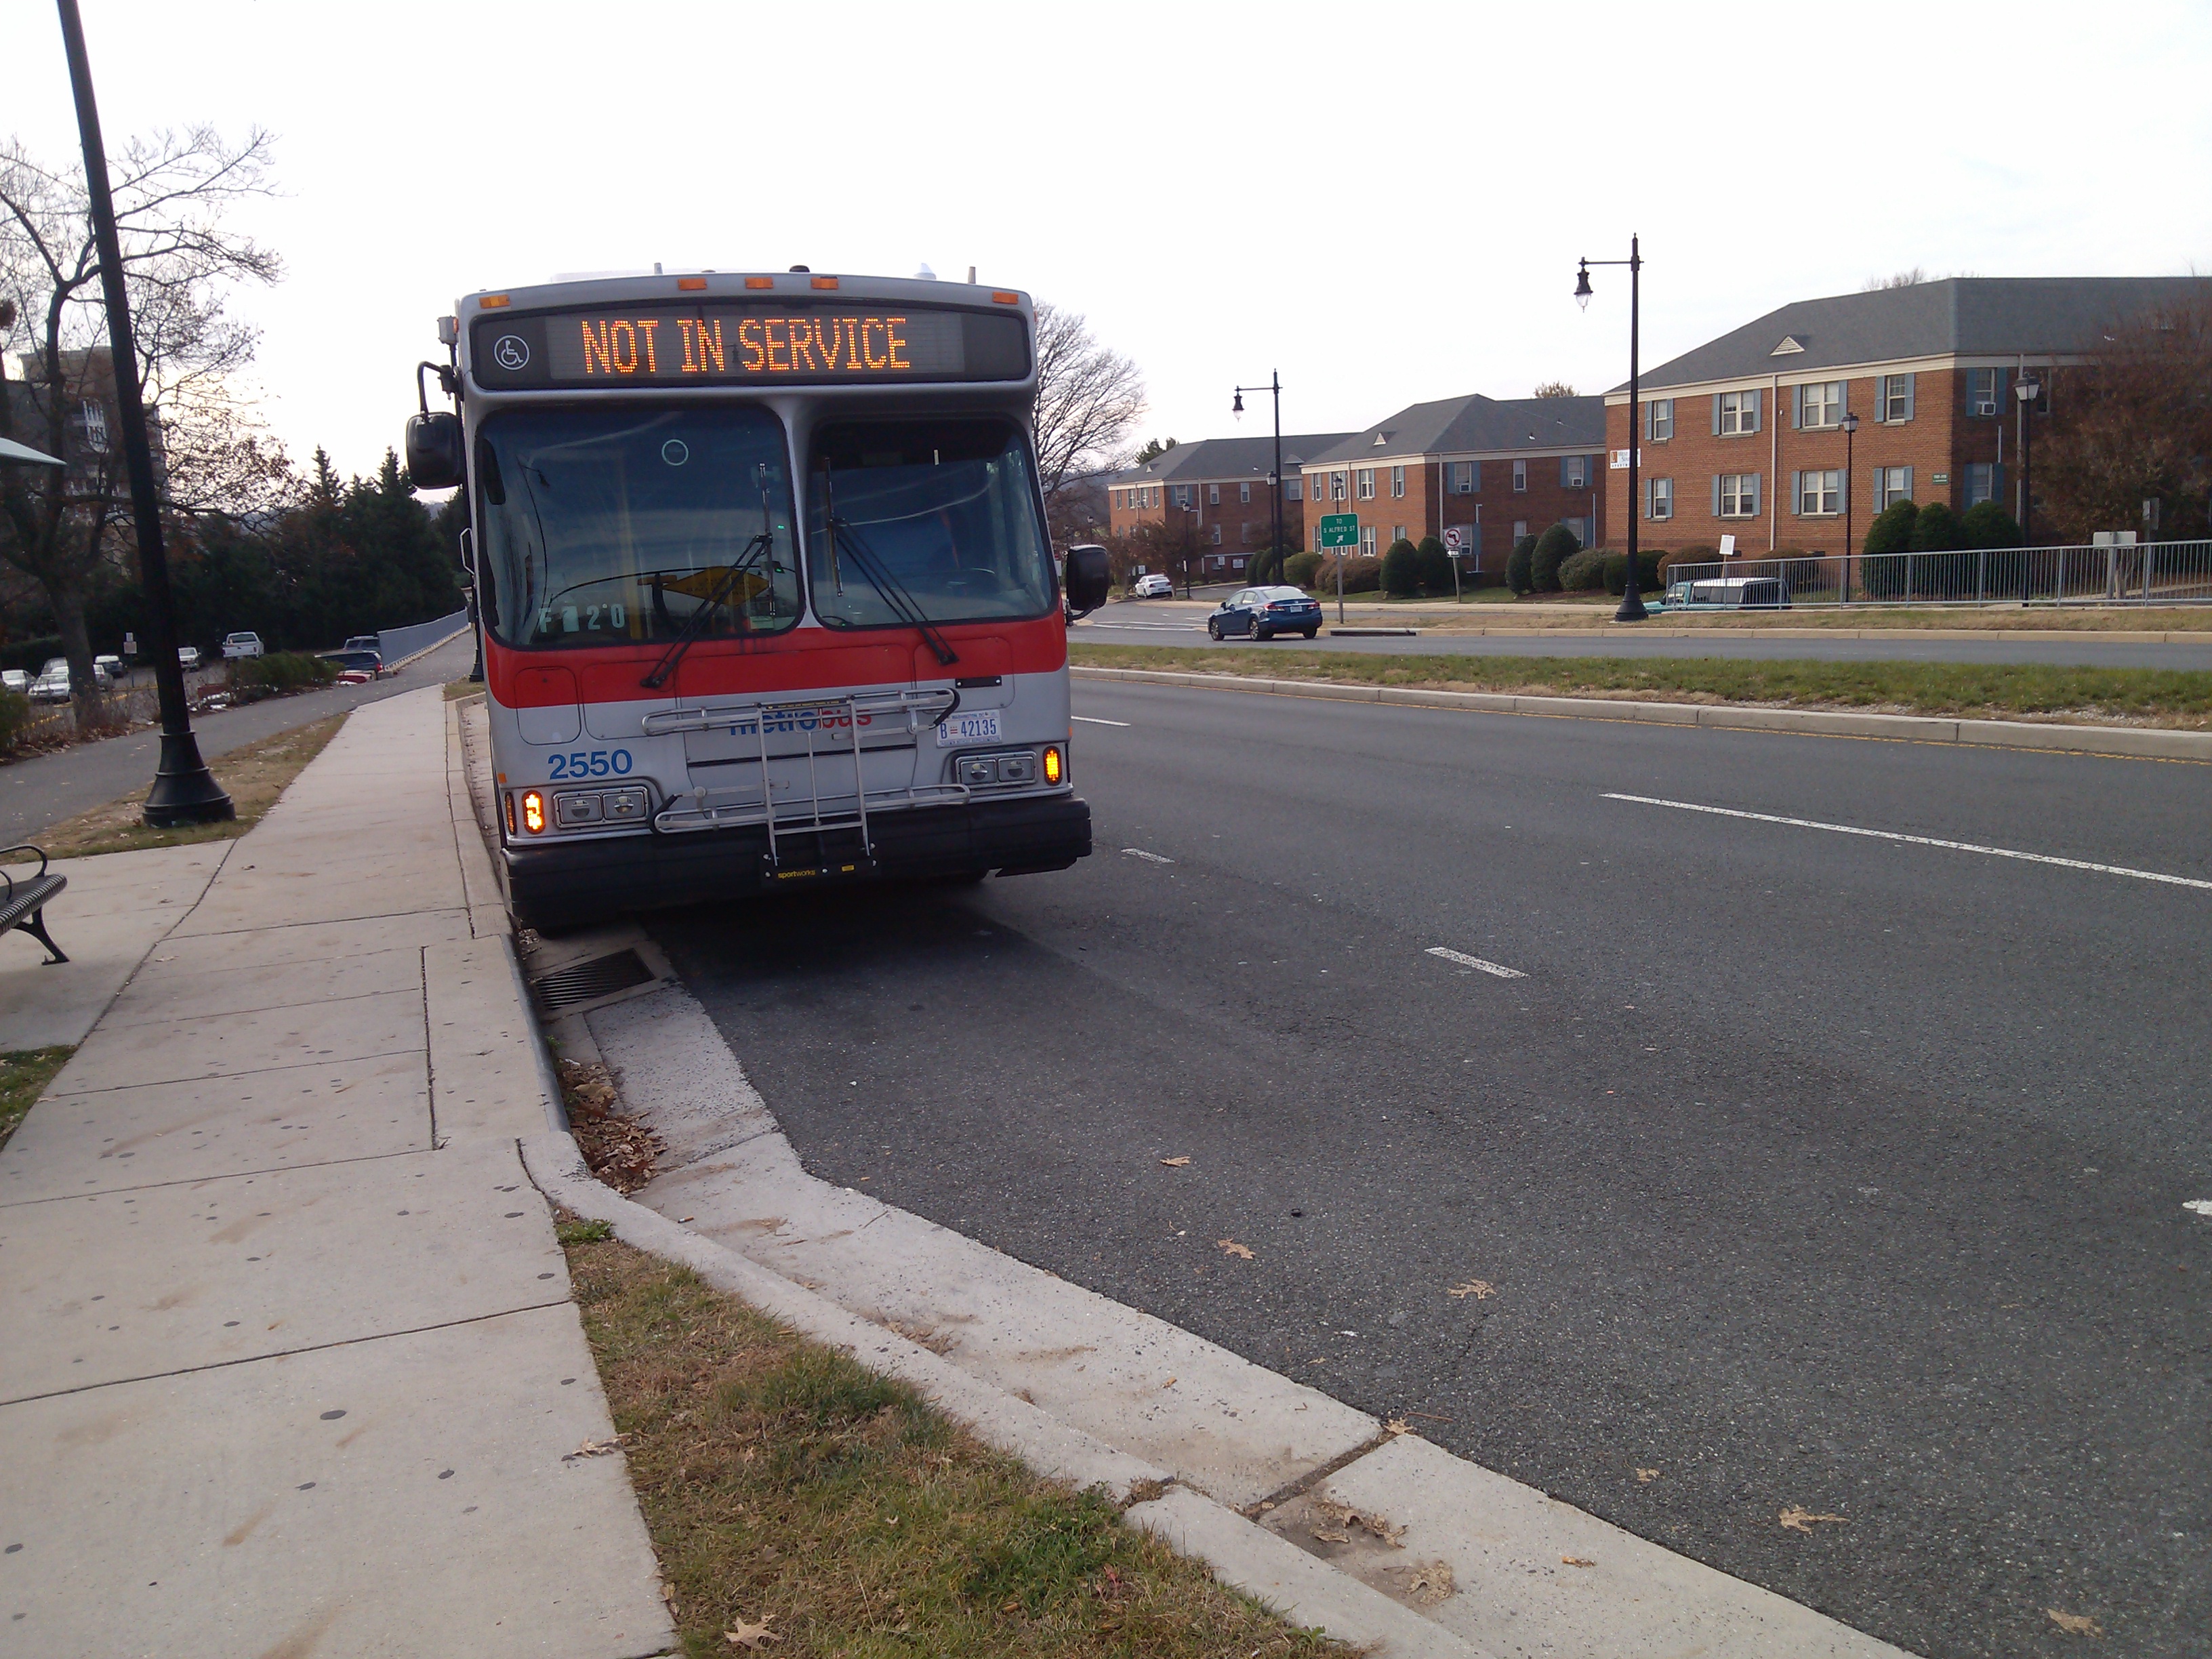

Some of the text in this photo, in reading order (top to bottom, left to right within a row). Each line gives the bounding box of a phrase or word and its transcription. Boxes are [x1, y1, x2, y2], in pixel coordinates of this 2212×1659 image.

[581, 317, 911, 373] NOT IN SERVICE
[940, 718, 997, 739] B 42135
[548, 749, 633, 780] 2550
[778, 869, 816, 880] sportworks
